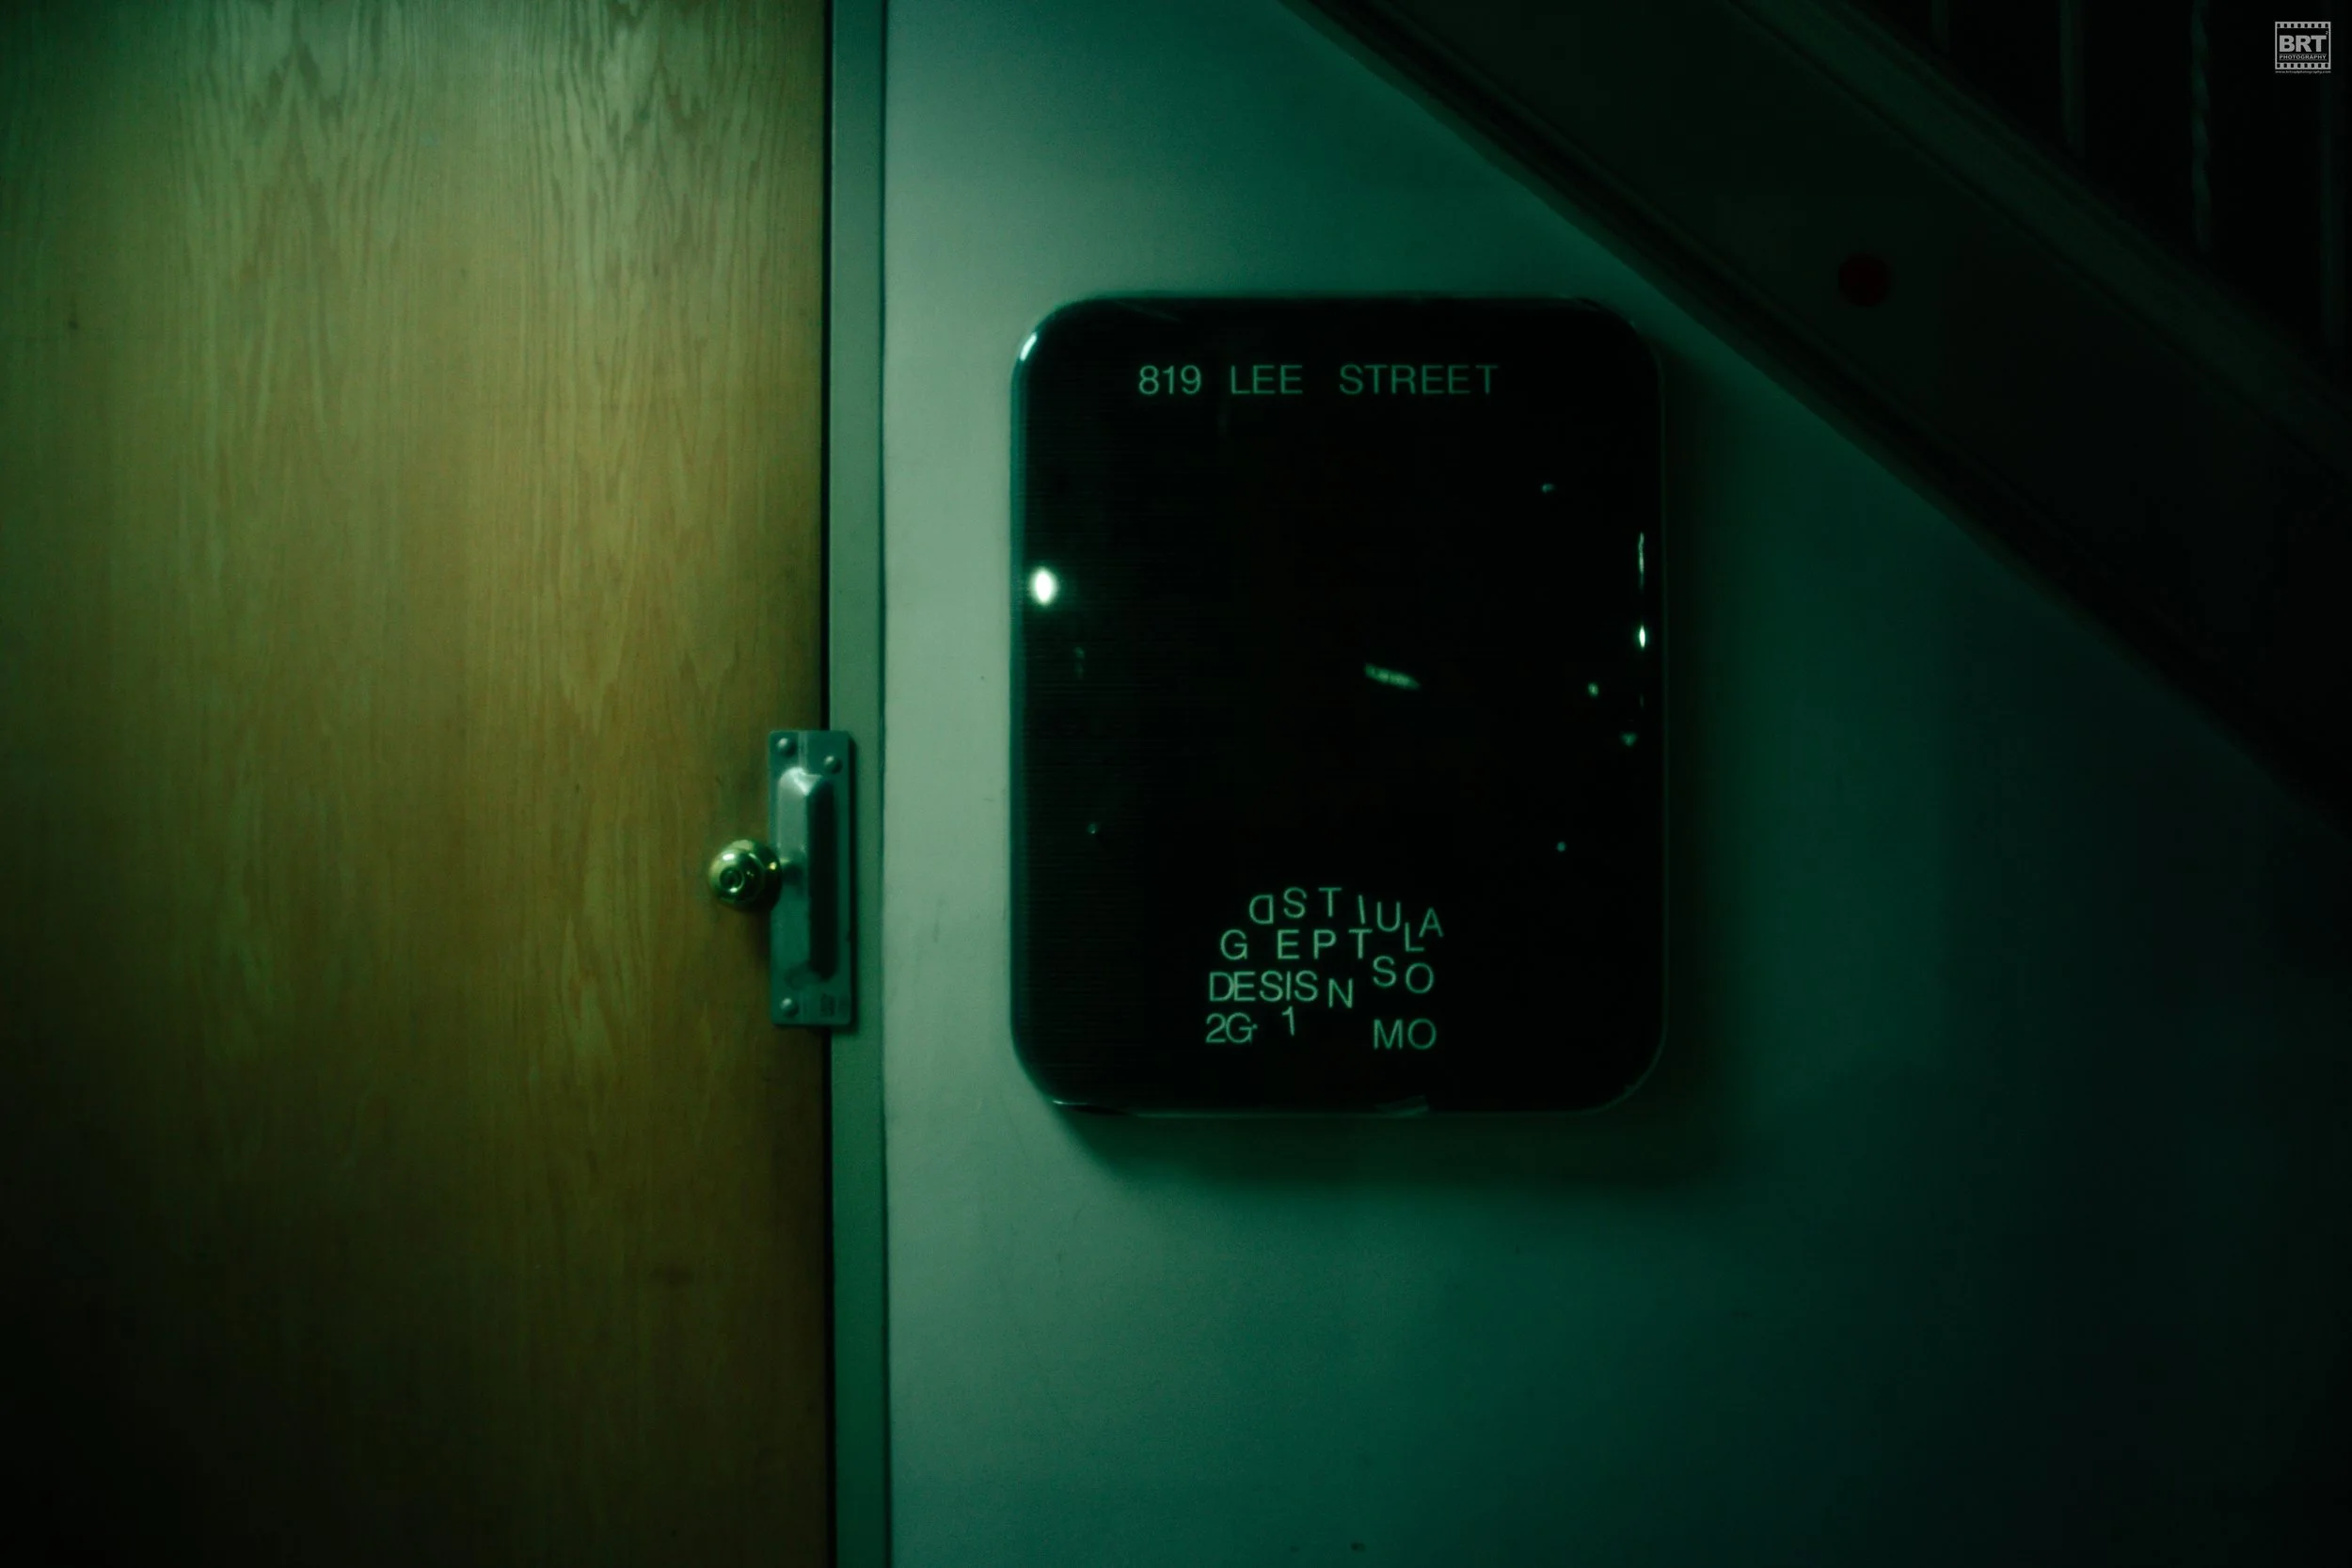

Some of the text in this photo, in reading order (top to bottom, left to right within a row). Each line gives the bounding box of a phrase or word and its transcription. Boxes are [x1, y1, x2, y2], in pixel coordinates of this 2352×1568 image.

[1136, 363, 1499, 396] 819 LEE STREET
[1373, 1017, 1438, 1051] MO
